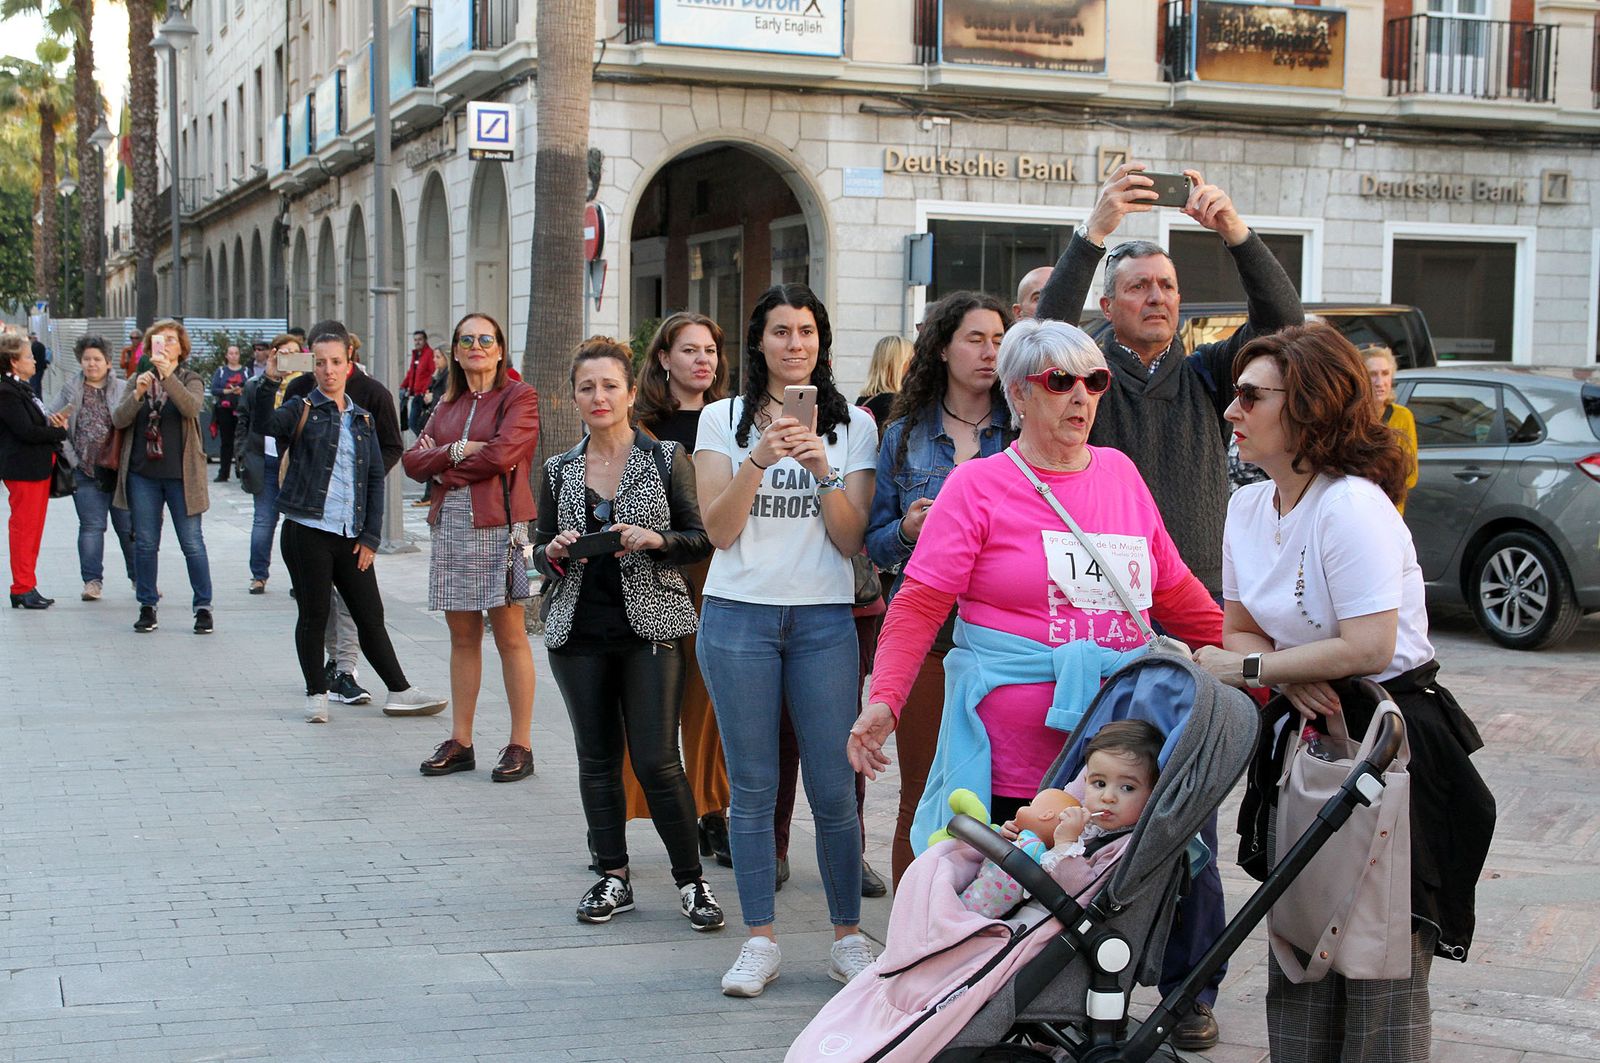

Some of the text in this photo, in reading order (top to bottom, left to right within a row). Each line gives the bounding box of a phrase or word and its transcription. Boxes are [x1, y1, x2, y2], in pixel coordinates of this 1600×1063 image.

[755, 16, 822, 36] Early English
[884, 147, 1076, 182] Deutsche Bank
[1361, 173, 1525, 202] Deutsche Bank
[771, 468, 811, 490] CAN
[749, 494, 821, 519] HEROES
[1096, 541, 1107, 549] de
[1119, 542, 1143, 552] Mujer
[1065, 552, 1104, 583] 14
